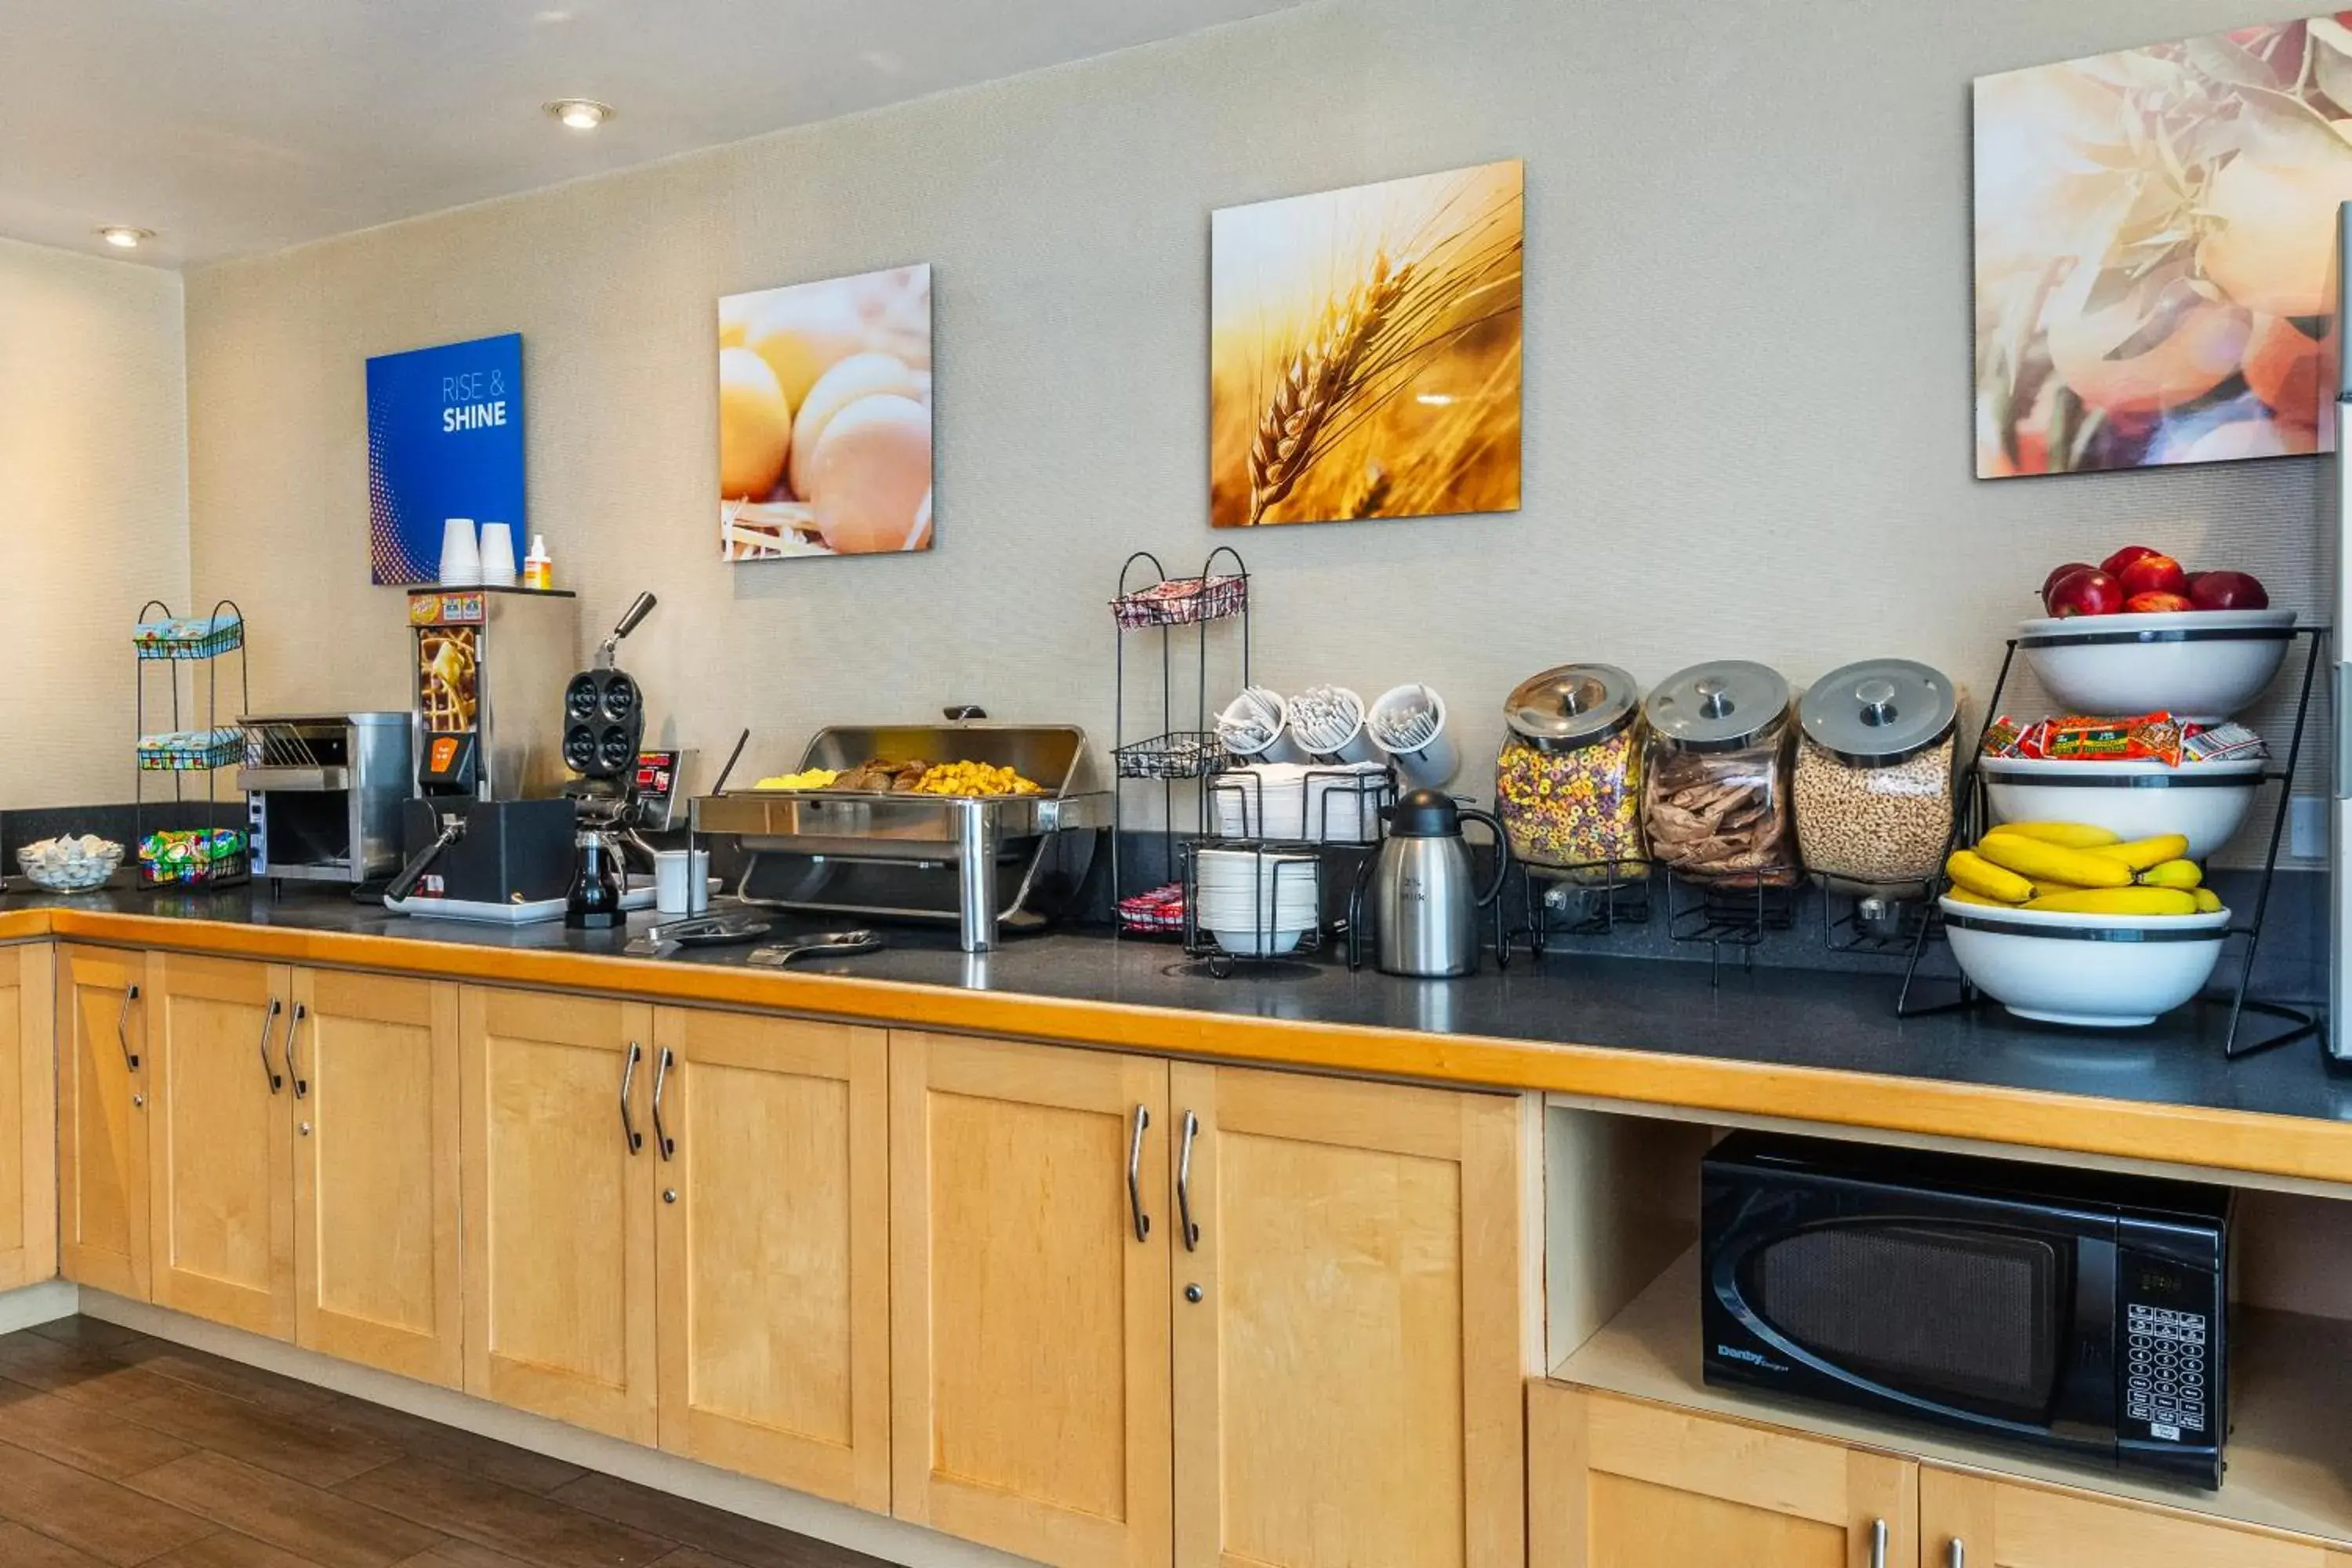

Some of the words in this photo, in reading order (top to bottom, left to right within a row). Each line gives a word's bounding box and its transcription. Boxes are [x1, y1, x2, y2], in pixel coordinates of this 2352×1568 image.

[443, 372, 484, 402] RISE
[490, 369, 505, 396] &
[443, 401, 507, 432] SHINE
[1718, 1345, 1762, 1365] Danby
